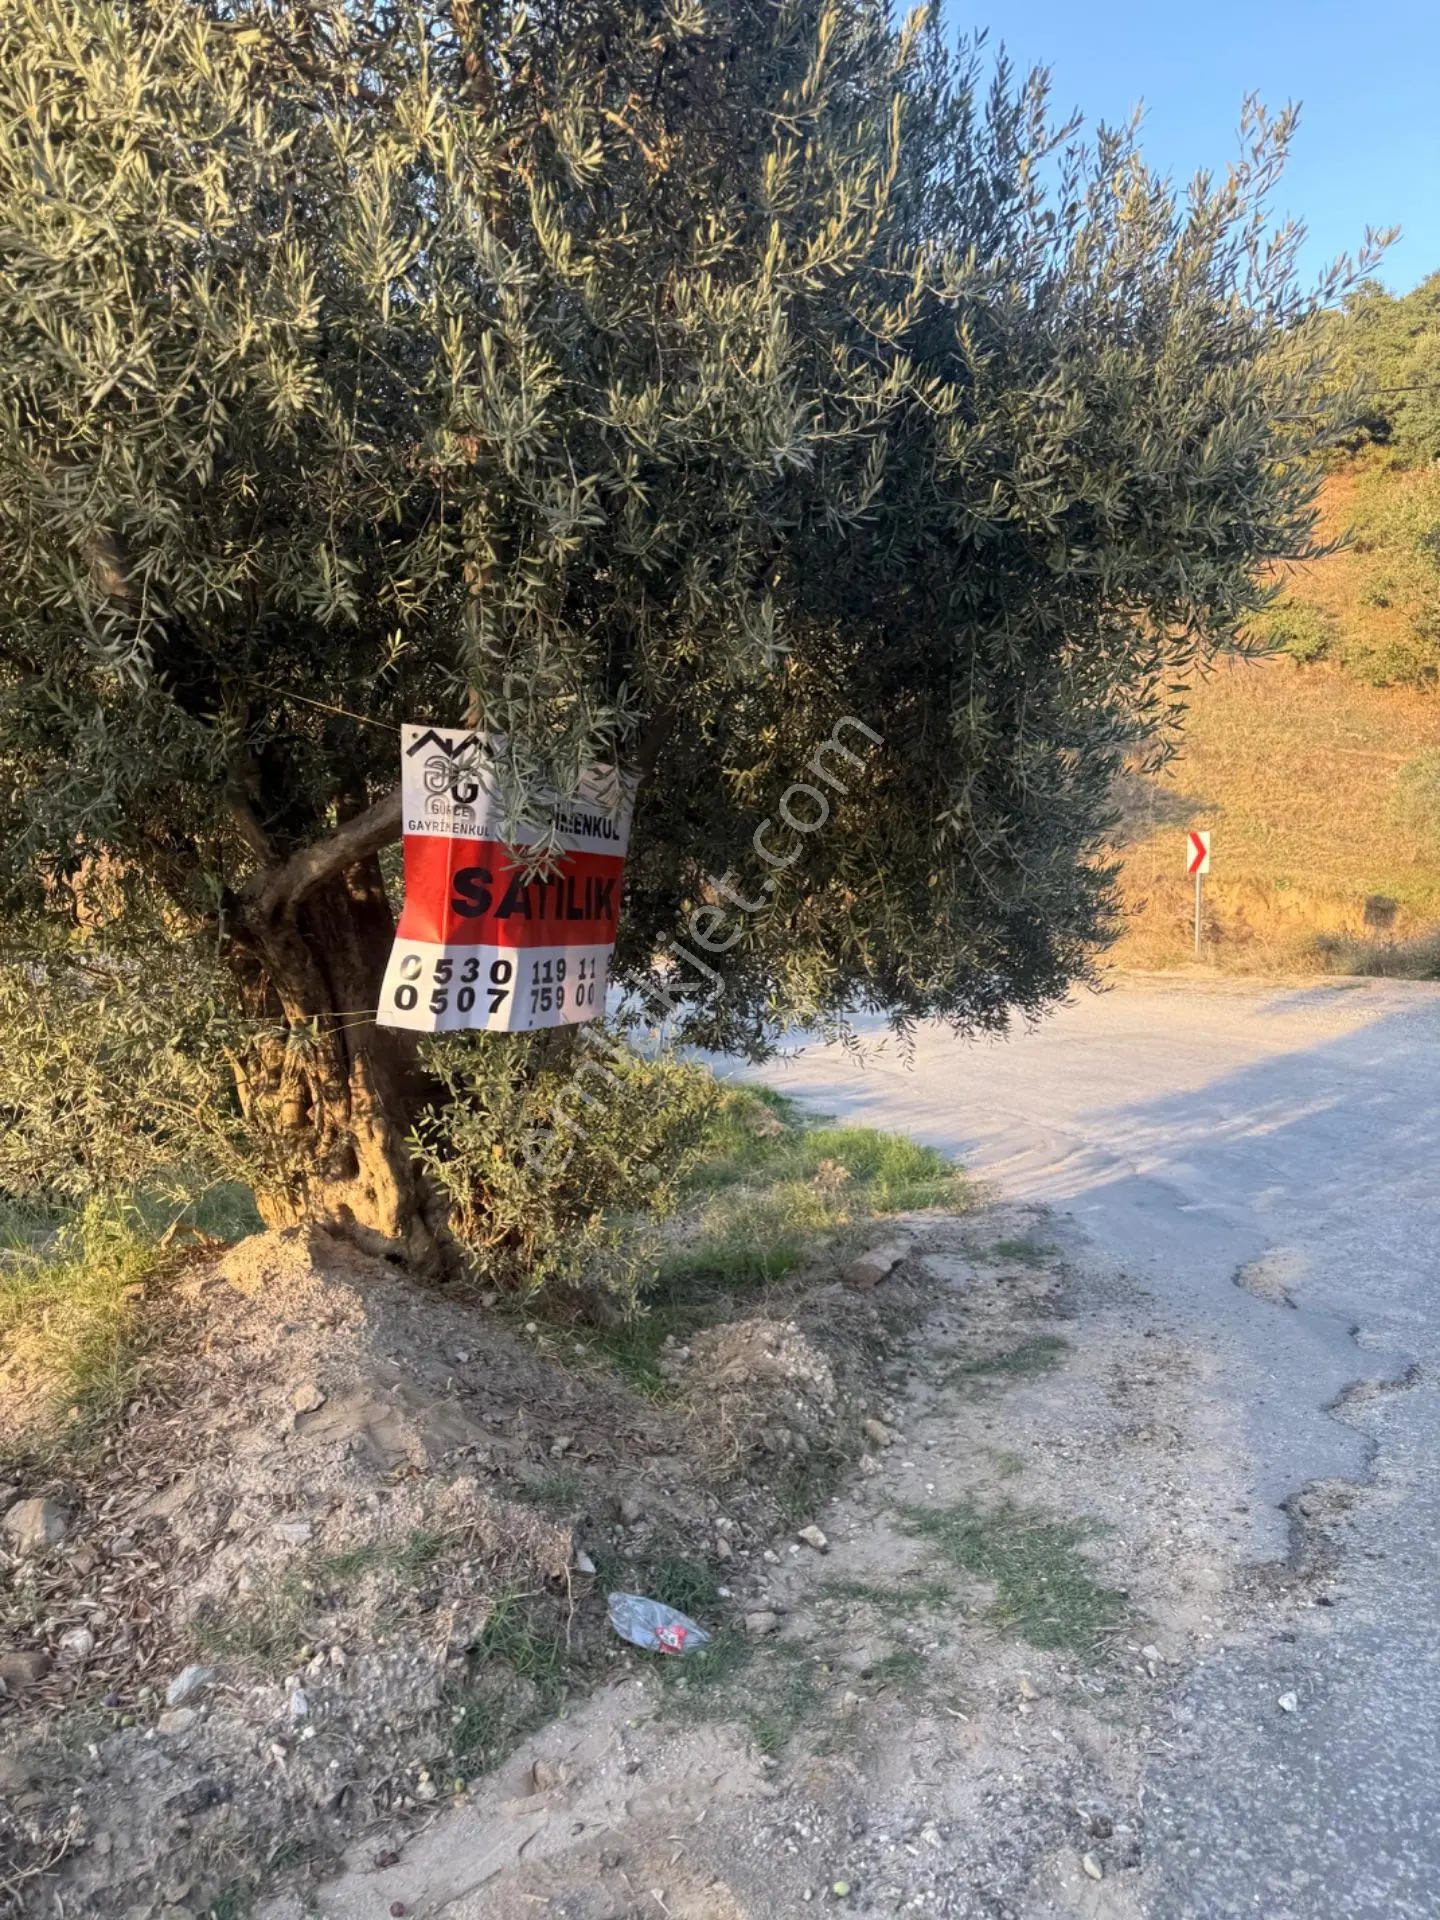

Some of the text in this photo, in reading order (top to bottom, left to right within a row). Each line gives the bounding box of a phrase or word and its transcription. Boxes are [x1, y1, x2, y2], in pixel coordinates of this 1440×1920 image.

[451, 867, 617, 921] SATILIK
[532, 958, 567, 985] 119
[531, 985, 565, 1014] 759
